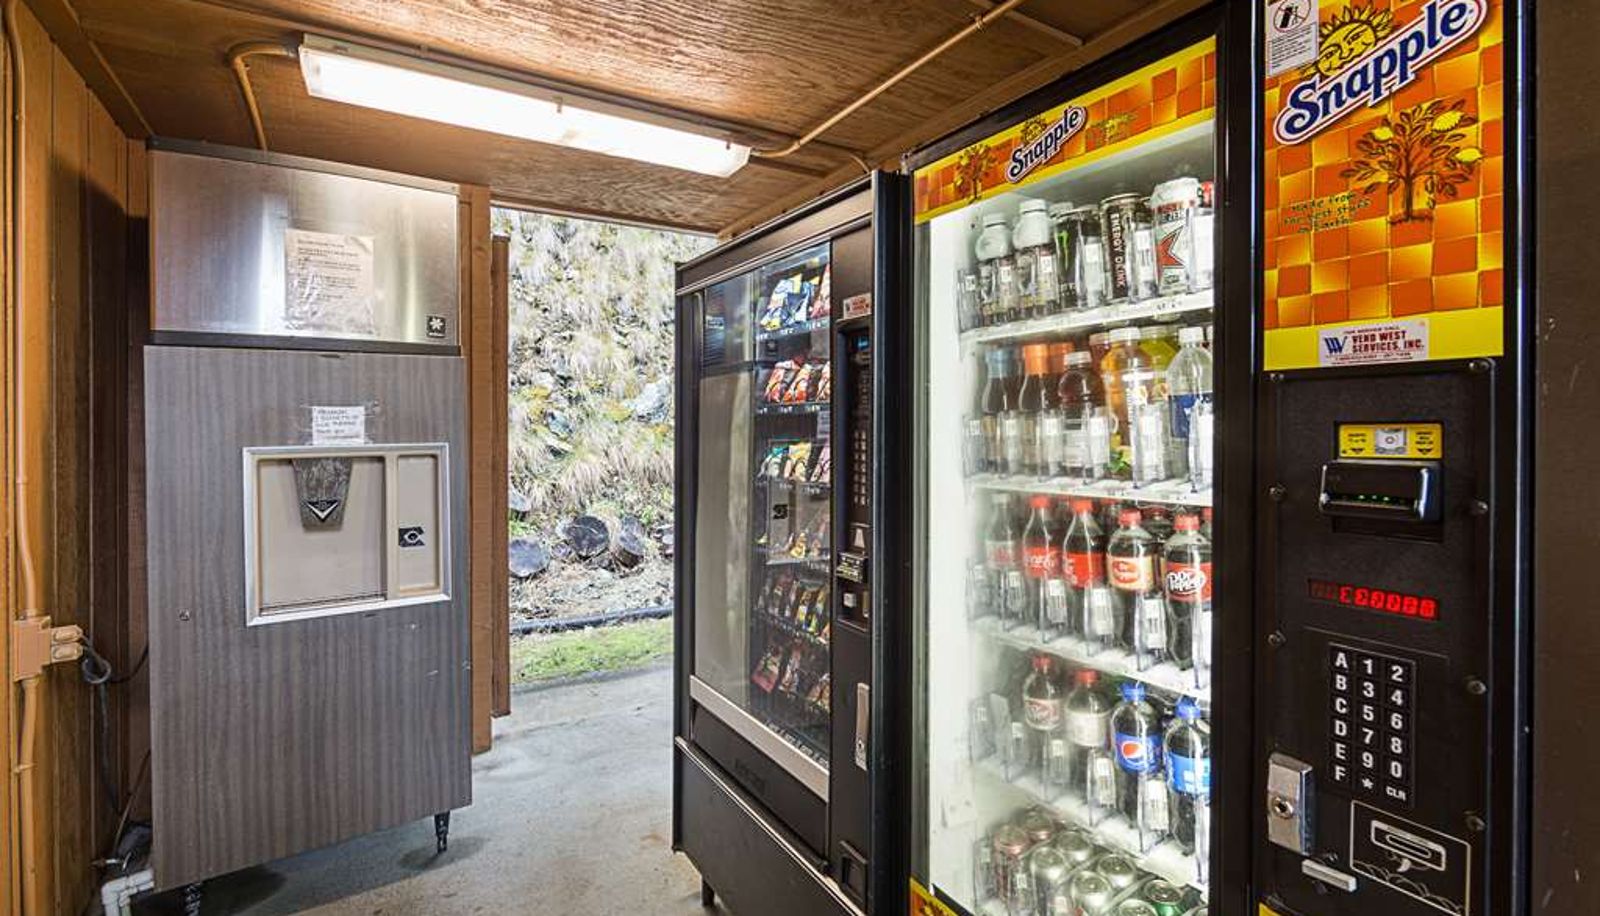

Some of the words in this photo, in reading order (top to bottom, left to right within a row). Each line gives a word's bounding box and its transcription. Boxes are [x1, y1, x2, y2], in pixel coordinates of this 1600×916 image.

[1285, 2, 1468, 136] Snapple
[1009, 107, 1080, 178] Snapple
[1352, 334, 1376, 344] VEND
[1379, 330, 1406, 341] WEST
[1404, 338, 1425, 349] INC.
[1335, 652, 1348, 669] A
[1363, 659, 1373, 675] 1
[1391, 666, 1404, 683] 2
[1335, 674, 1347, 691] B
[1362, 681, 1375, 698] 3
[1391, 689, 1403, 706] 4
[1335, 697, 1348, 714] C
[1362, 704, 1375, 722] 5
[1391, 713, 1403, 730] 6
[1335, 720, 1347, 737] D
[1362, 727, 1374, 745] 7
[1391, 736, 1403, 754] 8
[1335, 743, 1346, 760] E
[1362, 751, 1374, 769] 9
[1335, 766, 1346, 781] F
[1386, 786, 1406, 800] CLR
